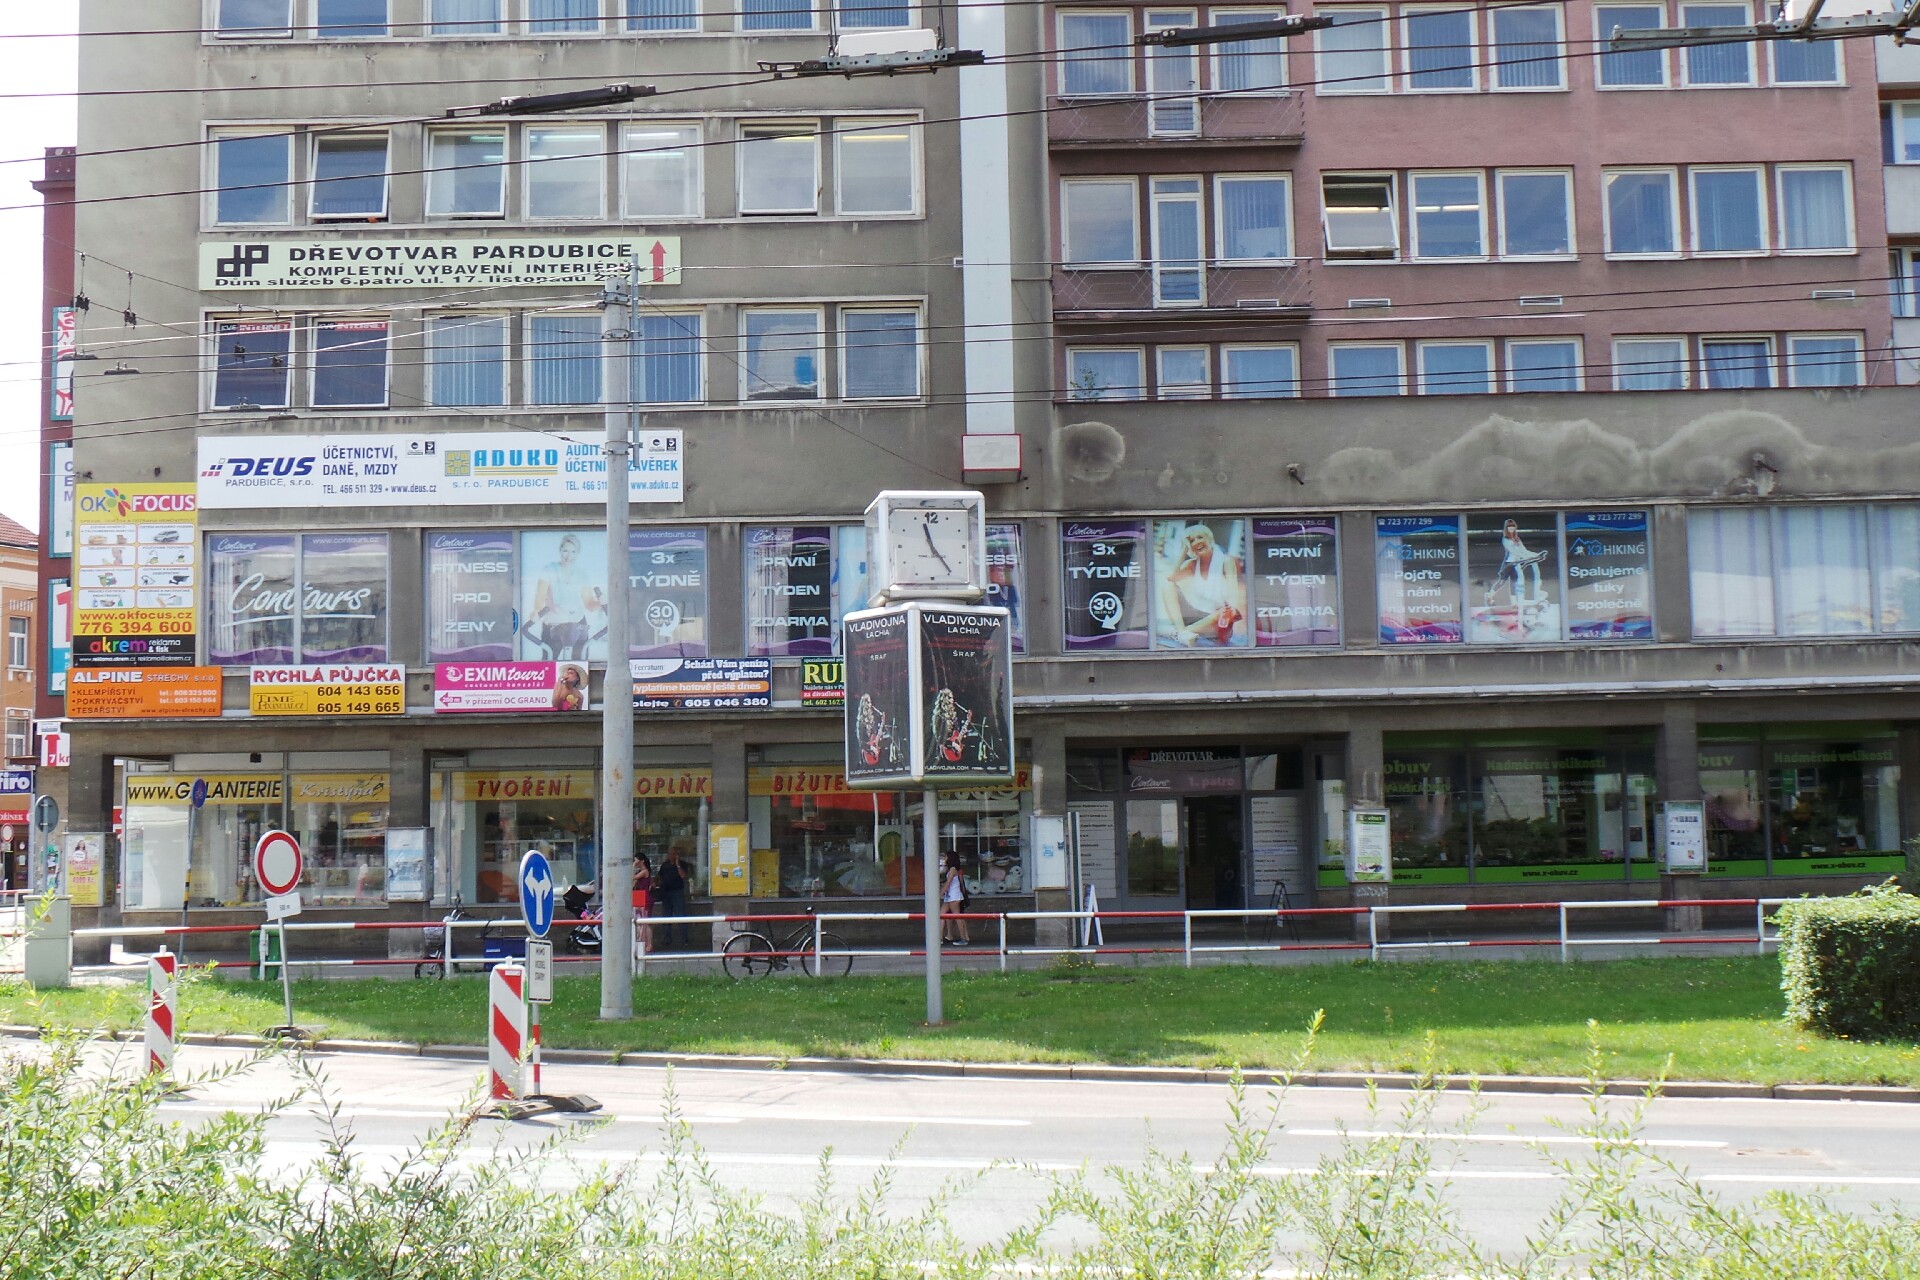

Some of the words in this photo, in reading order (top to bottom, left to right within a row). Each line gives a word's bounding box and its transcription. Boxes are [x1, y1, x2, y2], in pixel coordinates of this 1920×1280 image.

[289, 244, 457, 261] DŘEVOTVAR
[473, 244, 632, 259] PARDUBICE
[289, 263, 404, 276] KOMPLETNÍ
[414, 261, 512, 276] VYBAVENÍ
[215, 277, 260, 286] Dům
[268, 276, 334, 286] služeb
[340, 277, 414, 286] 6.patro
[421, 276, 444, 284] ul.
[453, 276, 482, 284] 17.
[489, 275, 586, 284] listopadu
[323, 444, 398, 460] ÚČETNICTVÍ,
[566, 444, 600, 456] AUDIT
[474, 450, 558, 466] ADUKO
[227, 457, 316, 476] DEUS
[323, 462, 358, 477] DANĚ,
[364, 463, 398, 476] MZDY
[226, 478, 286, 488] PARDUBICE,
[323, 485, 337, 494] TEL.
[340, 485, 354, 494] 466
[355, 485, 368, 494] 511
[370, 484, 382, 494] 329
[391, 484, 437, 493] www.deus.cz
[452, 480, 461, 488] s.
[464, 480, 471, 488] r.
[474, 480, 482, 488] o.
[488, 478, 549, 488] PARDUBICE
[566, 482, 579, 490] TEL.
[582, 481, 594, 490] 466
[631, 480, 679, 490] www.aduko.cz
[132, 495, 195, 512] FOCUS
[924, 512, 938, 524] 12
[1388, 518, 1401, 526] 723
[1597, 513, 1612, 521] 723
[1628, 512, 1642, 520] 299
[1092, 543, 1116, 556] 3x
[1268, 544, 1321, 558] PRVNÍ
[651, 552, 675, 564] 3x
[762, 552, 816, 567] PRVNÍ
[432, 562, 509, 573] FITNESS
[1068, 561, 1141, 579] TÝDNĚ
[1570, 566, 1644, 578] Spalujeme
[629, 570, 700, 588] TÝDNĚ
[1266, 572, 1326, 586] TÝDEN
[1394, 570, 1442, 582] Pojďte
[228, 572, 371, 614] Contours
[760, 582, 820, 596] TÝDEN
[1407, 586, 1442, 597] námi
[1594, 582, 1625, 594] tuky
[452, 592, 491, 603] PRO
[1093, 598, 1116, 611] 30
[1408, 604, 1453, 613] vrchol
[1576, 599, 1642, 612] společně
[80, 611, 192, 620] www.okfocus.cz
[650, 606, 672, 618] 30
[1258, 606, 1335, 617] ZDARMA
[445, 618, 496, 632] ŽENY
[750, 616, 829, 627] ZDARMA
[848, 615, 905, 633] VLADIVOJNA
[923, 614, 1001, 627] VLADIVOJNA
[80, 622, 112, 634] 776
[120, 622, 152, 634] 394
[159, 621, 192, 633] 600
[875, 629, 890, 637] CHIA
[948, 626, 958, 634] LA
[959, 627, 980, 635] CHIA
[90, 636, 147, 652] akrem
[684, 660, 714, 669] Schází
[717, 660, 737, 668] Vám
[739, 660, 769, 669] peníze
[72, 672, 143, 682] ALPINE
[146, 673, 190, 682] STŘECHY
[254, 667, 324, 682] RYCHLÁ
[330, 666, 401, 682] PŮJČKA
[702, 670, 723, 681] před
[725, 670, 769, 680] výplatou?
[77, 687, 136, 696] KLEMPÍŘSTVÍ
[318, 686, 342, 696] 604
[347, 686, 370, 696] 143
[376, 686, 400, 695] 656
[680, 682, 711, 691] hotové
[738, 682, 761, 690] dnes
[318, 703, 342, 712] 605
[347, 702, 370, 712] 149
[376, 702, 400, 712] 665
[472, 698, 502, 706] přízemí
[743, 698, 768, 706] 380
[77, 706, 125, 714] TESAŘSTVÍ
[1150, 750, 1214, 762] DŘEVOTVAR
[1699, 752, 1734, 767] buv
[478, 774, 571, 797] TVOŘENÍ
[636, 773, 707, 796] OPLŇK
[773, 771, 848, 792] BIŽUTE
[128, 780, 281, 800] www.GLANTERIE
